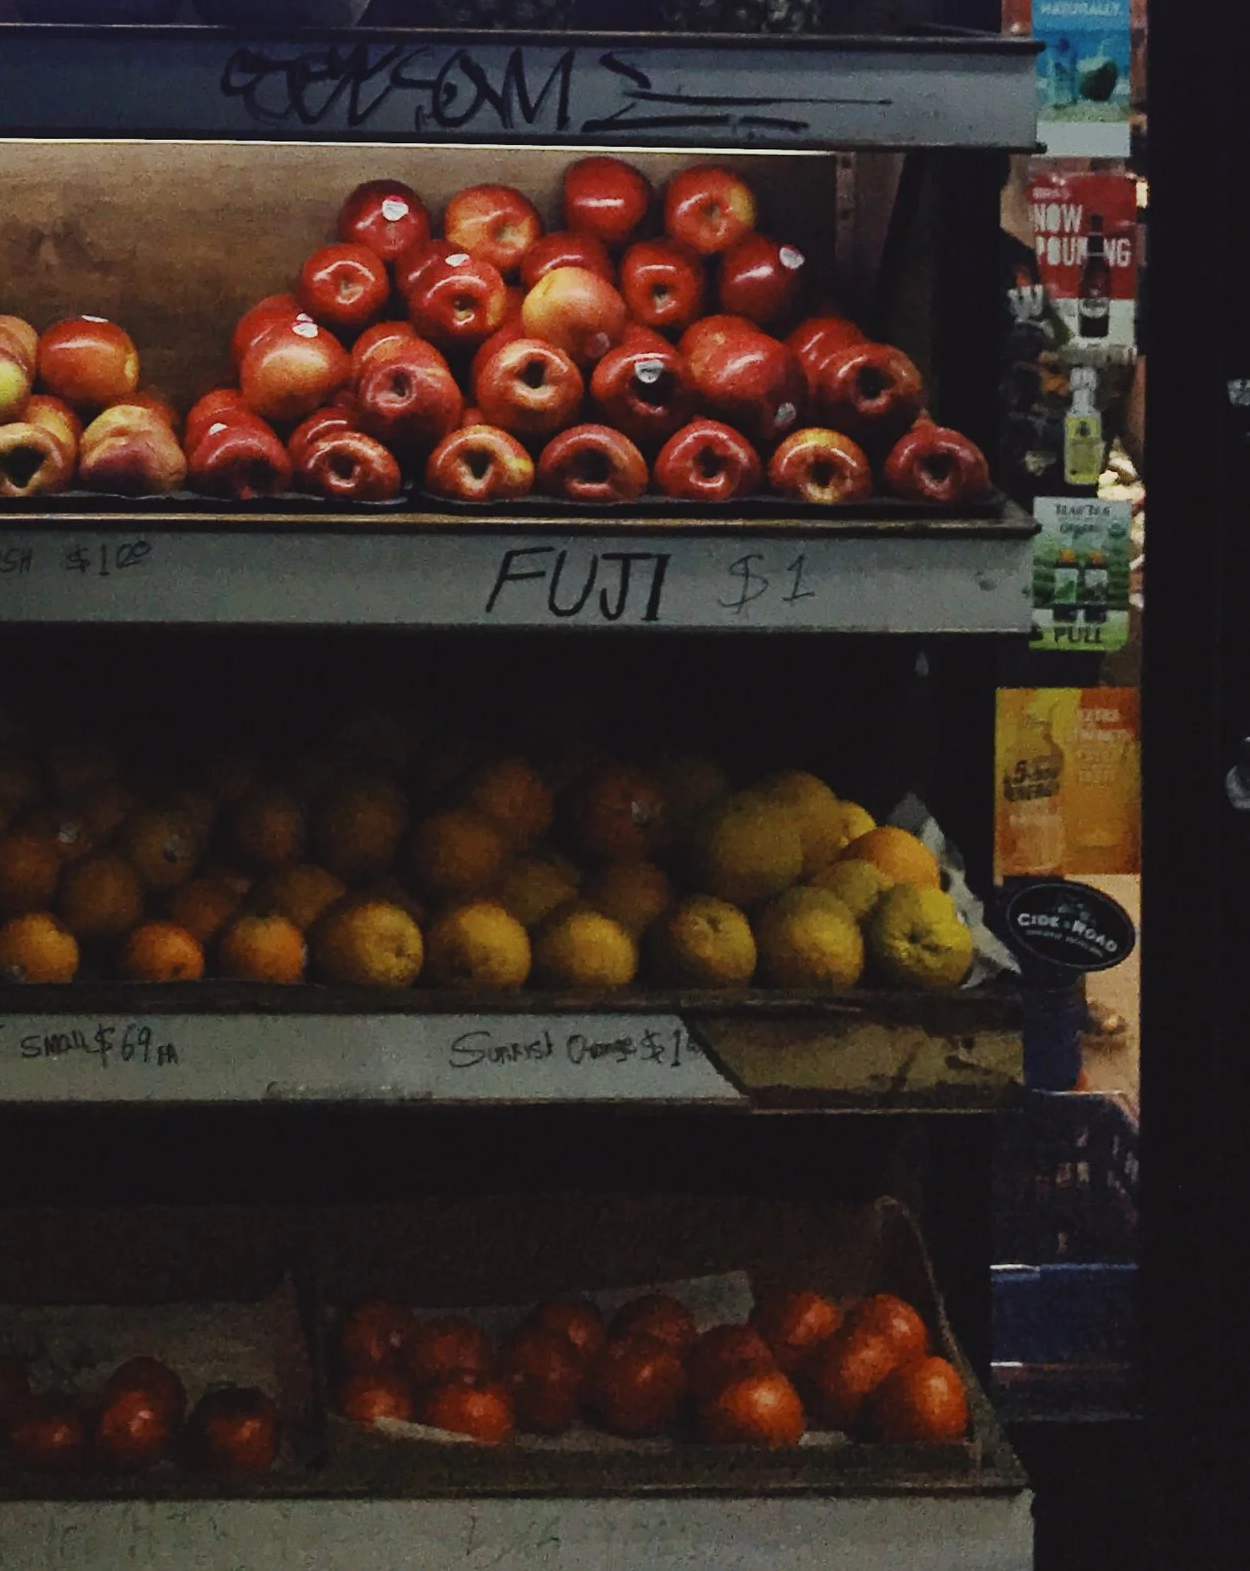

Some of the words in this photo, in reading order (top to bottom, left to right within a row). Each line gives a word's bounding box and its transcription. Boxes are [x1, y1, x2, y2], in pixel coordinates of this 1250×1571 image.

[1033, 202, 1083, 233] NOW
[1035, 235, 1133, 268] POURNG
[485, 545, 673, 622] FUJI
